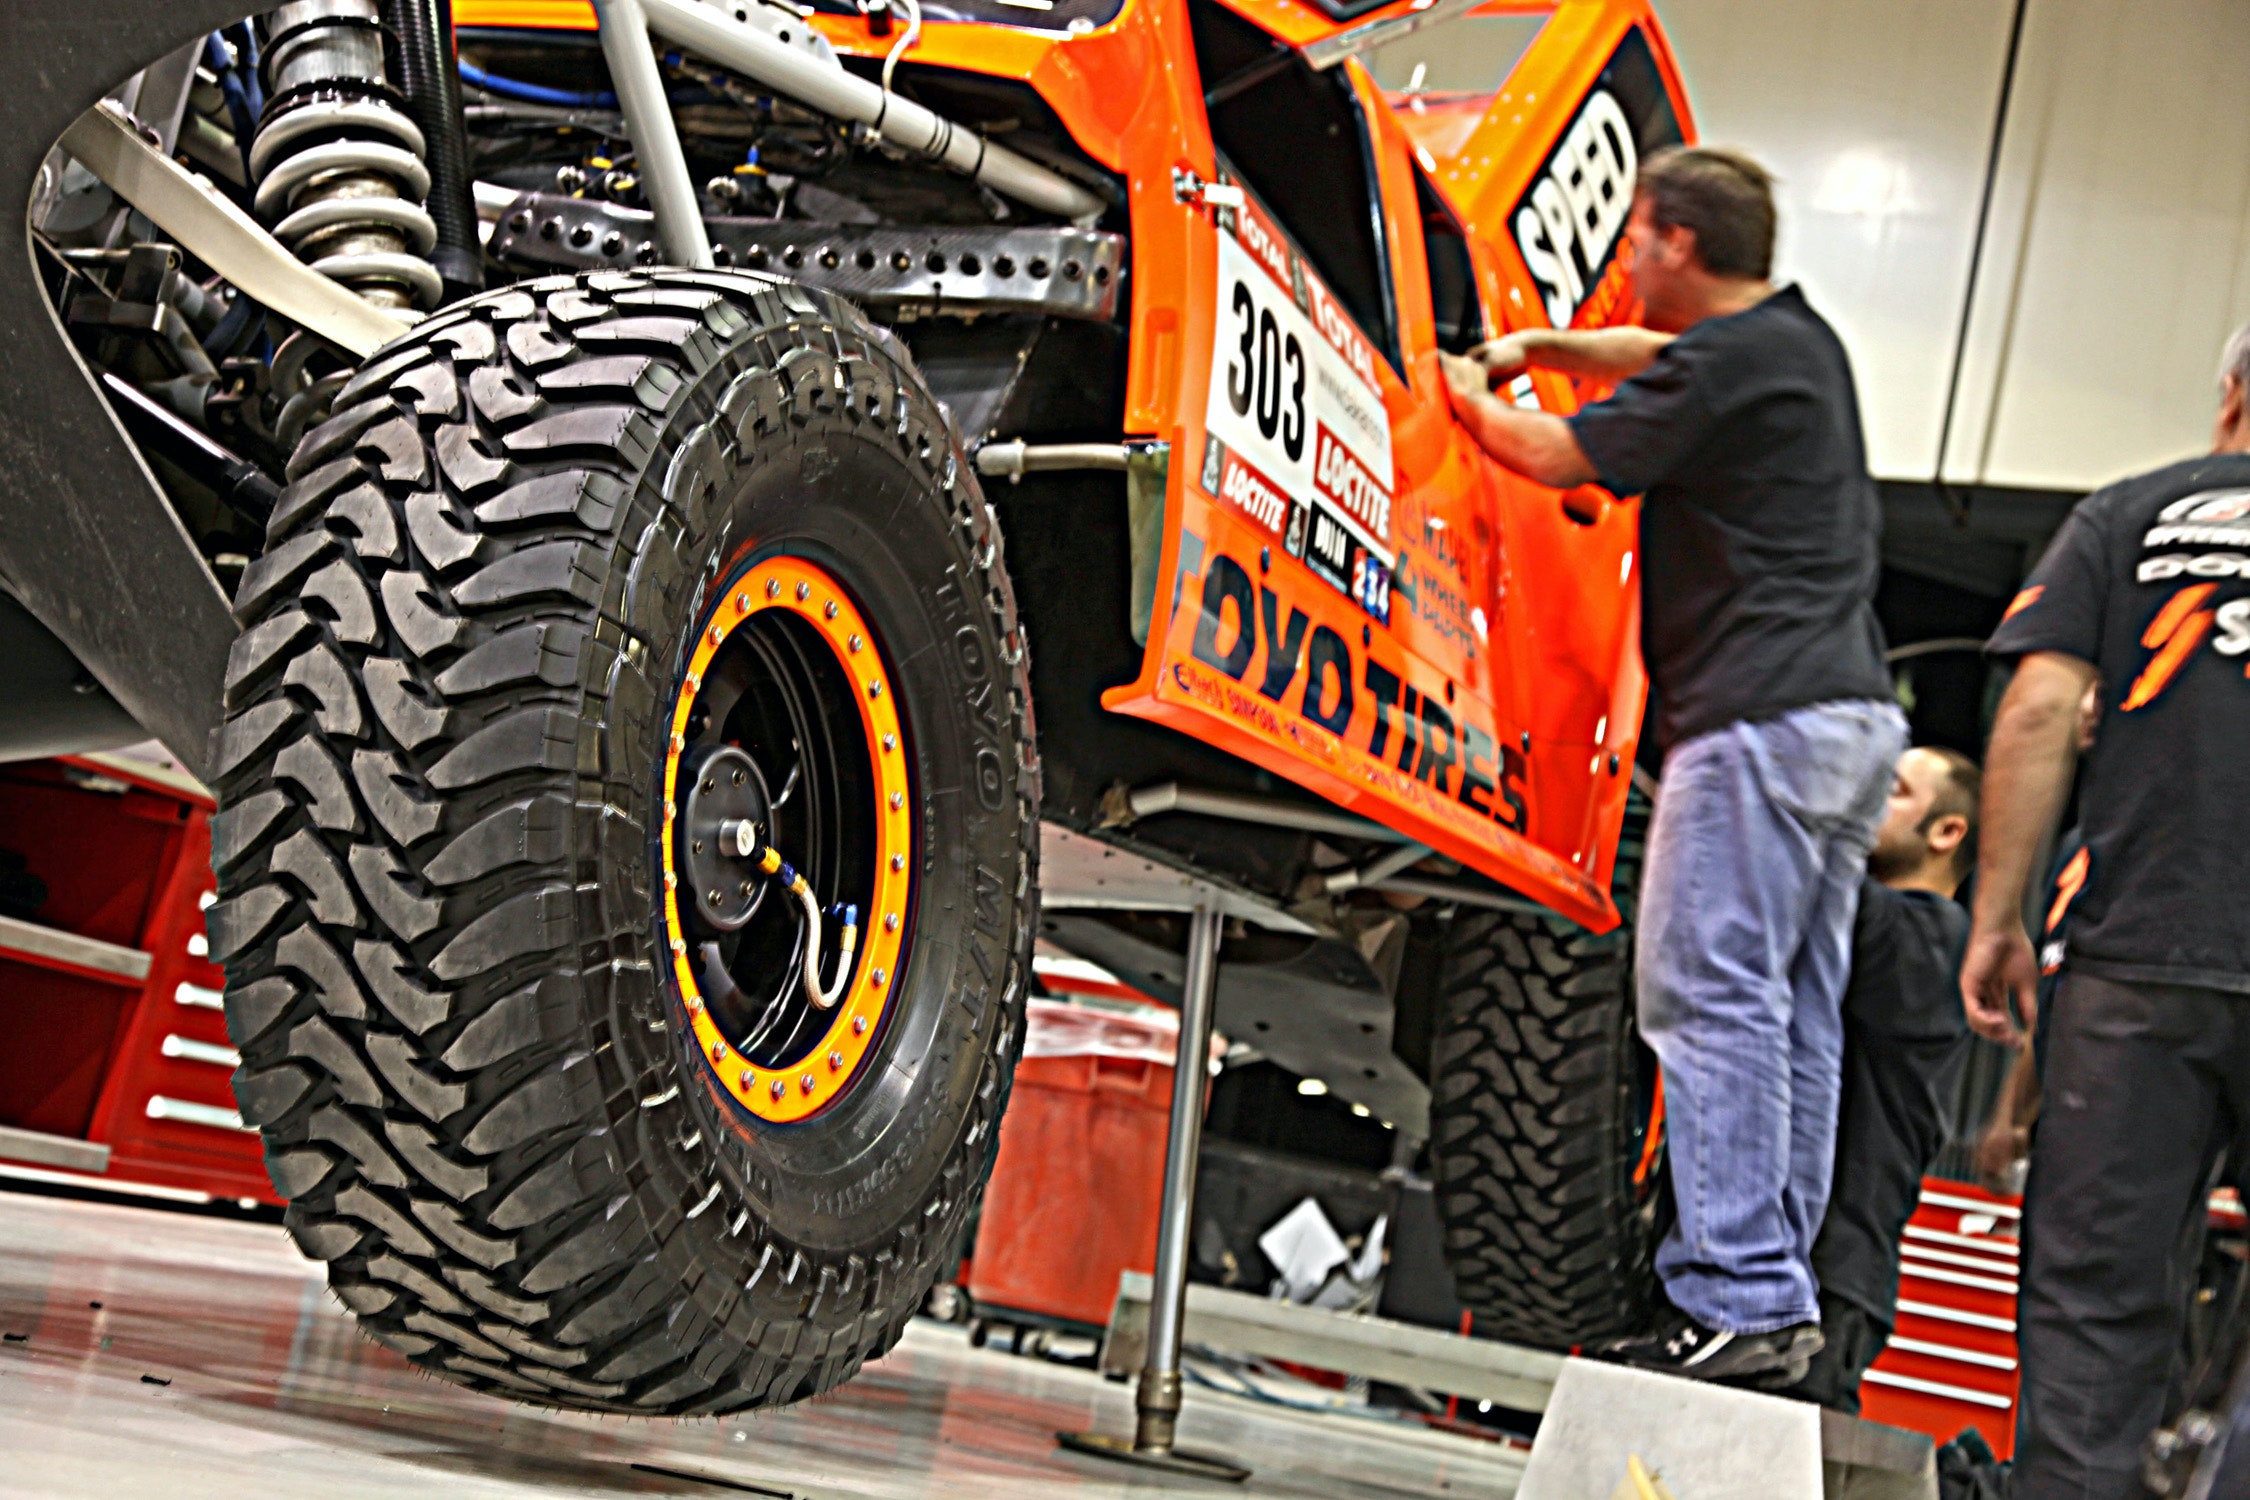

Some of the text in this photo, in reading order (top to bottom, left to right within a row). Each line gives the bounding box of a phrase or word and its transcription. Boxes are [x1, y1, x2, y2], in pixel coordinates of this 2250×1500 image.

[1239, 203, 1293, 288] TOTAL
[1516, 90, 1638, 330] SPEED
[1228, 279, 1306, 463] 303
[1305, 273, 1384, 399] TOTAL
[1223, 461, 1287, 534] LOCTITE
[1317, 433, 1391, 540] LOCTITE
[936, 561, 1004, 813] TOYO
[1366, 657, 1528, 837] TIRES
